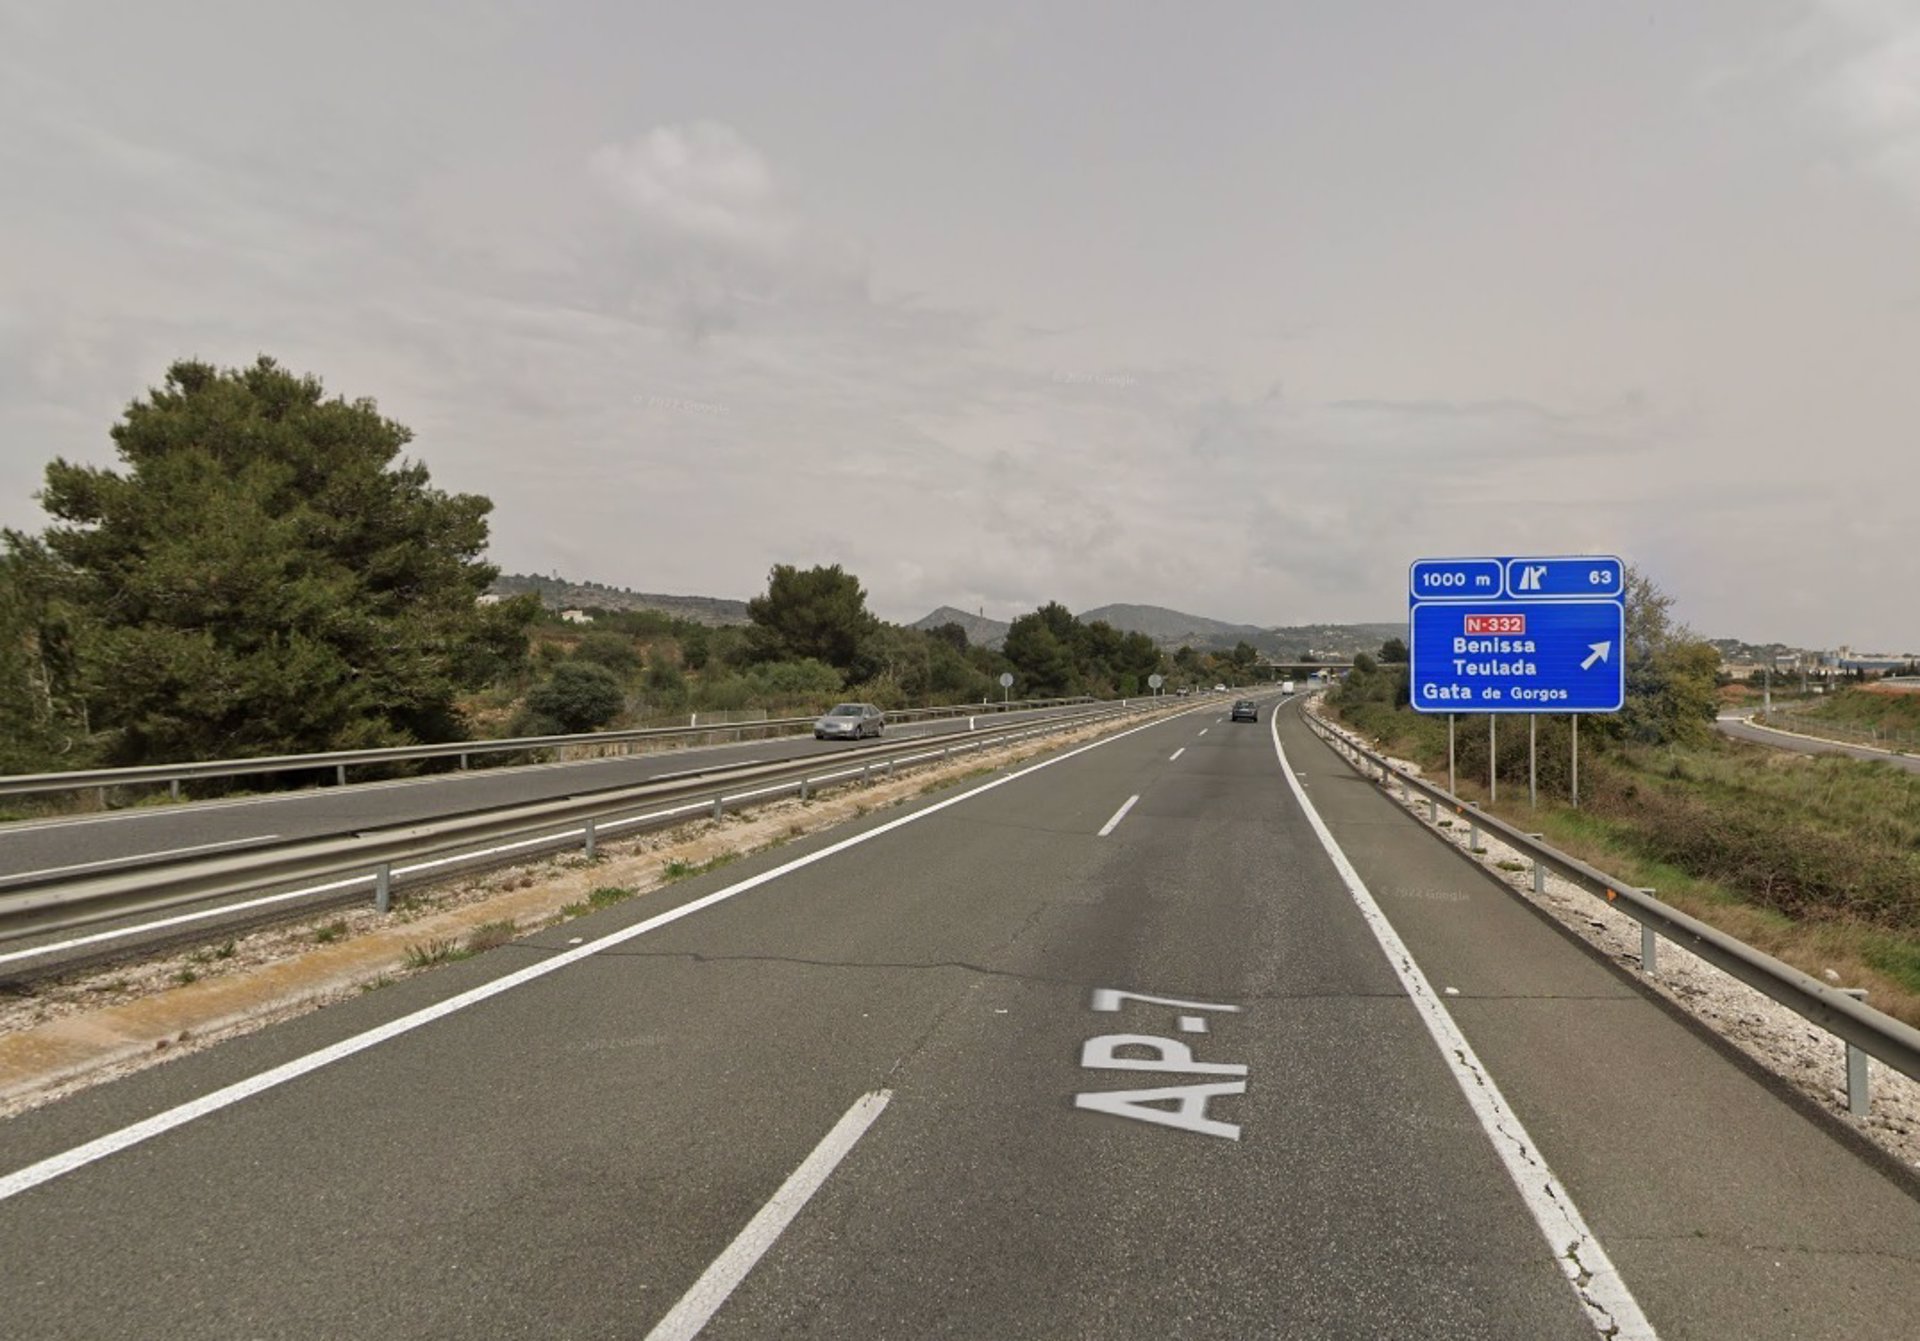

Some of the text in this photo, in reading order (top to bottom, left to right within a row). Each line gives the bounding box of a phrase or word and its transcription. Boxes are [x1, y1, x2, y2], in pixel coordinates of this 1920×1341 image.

[1422, 572, 1491, 586] 1000 m
[1588, 570, 1612, 585] 63
[1467, 618, 1521, 632] N-332
[1453, 637, 1536, 653] Benissa
[1453, 659, 1537, 675] Teulada
[1423, 683, 1568, 702] Gata de Gorgos
[1075, 988, 1248, 1141] AP-7
